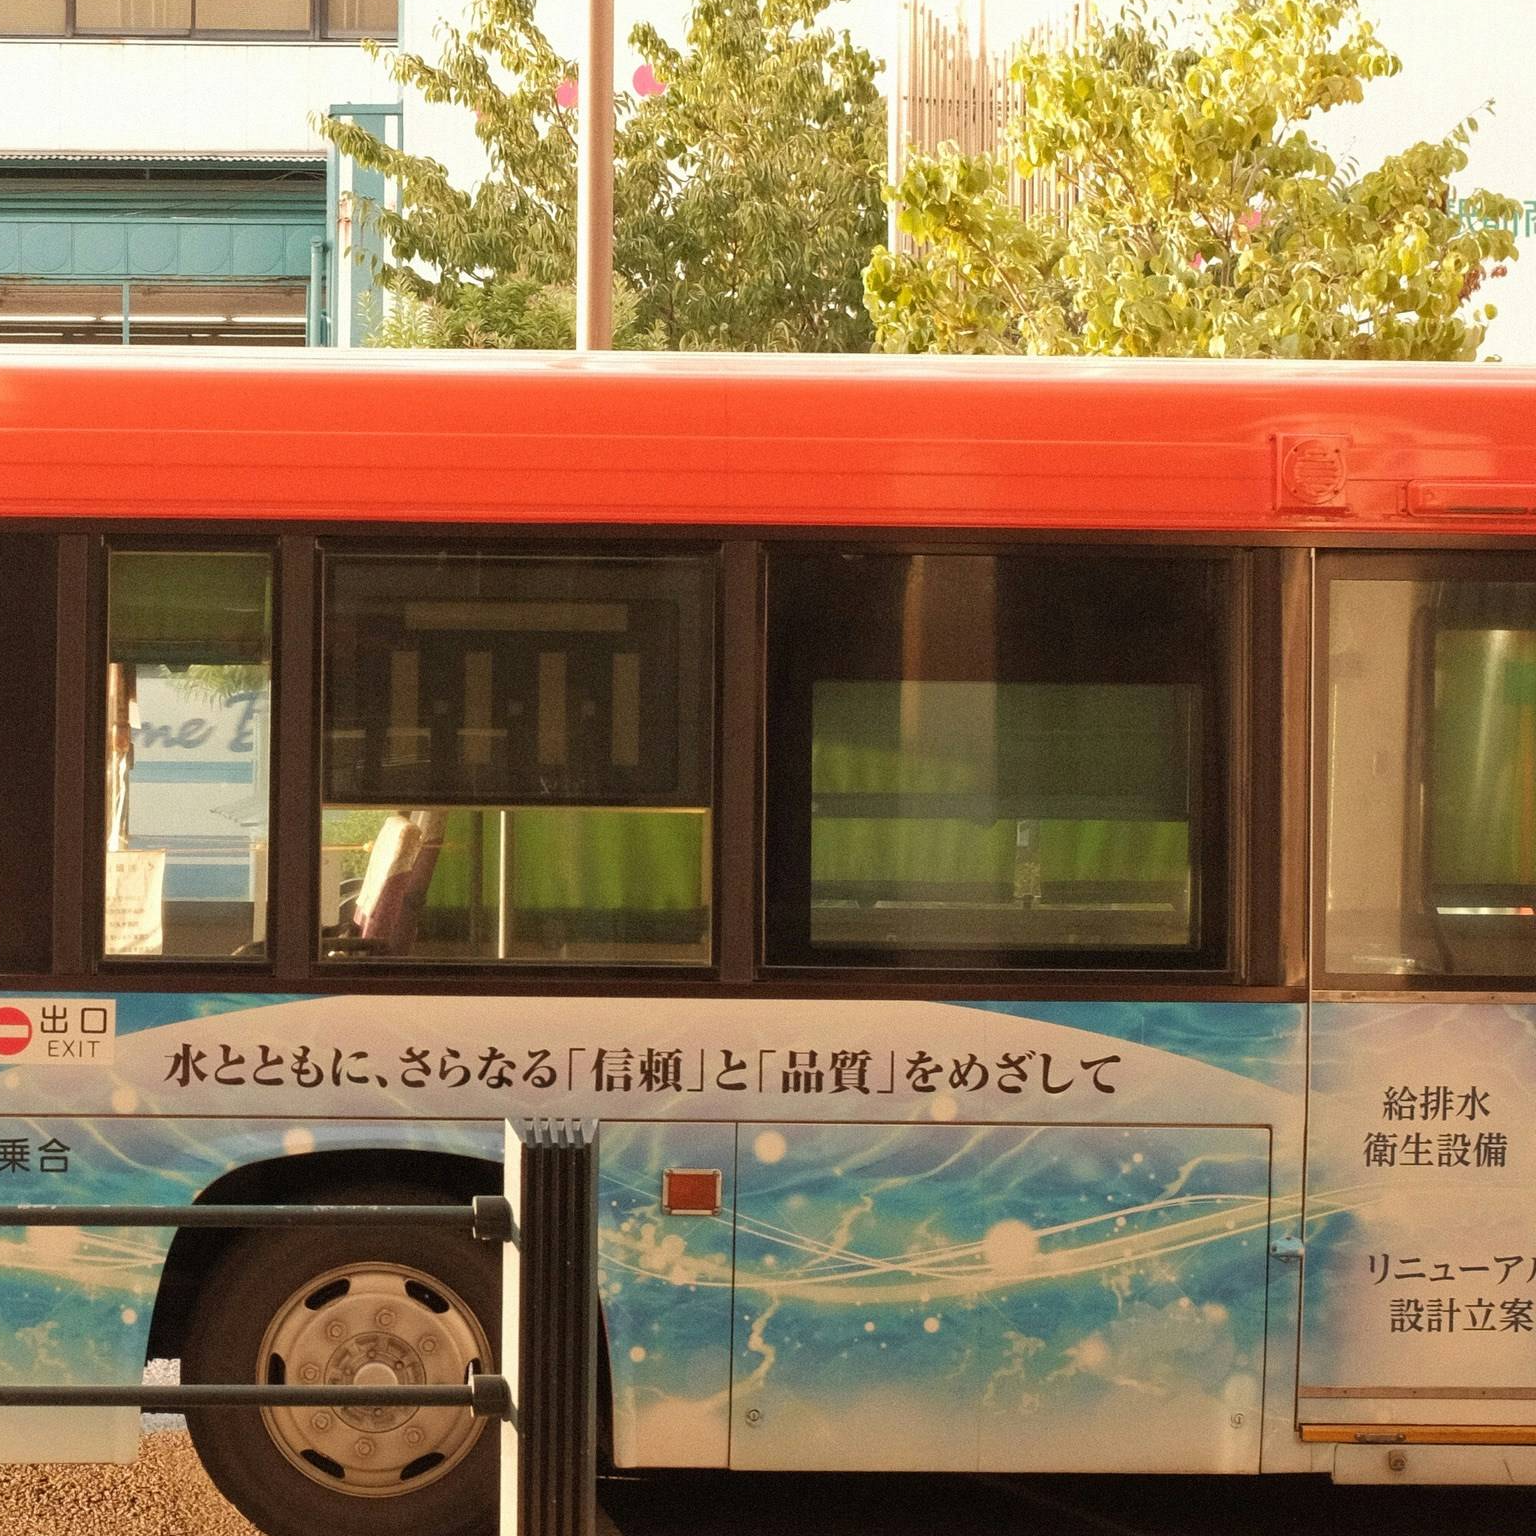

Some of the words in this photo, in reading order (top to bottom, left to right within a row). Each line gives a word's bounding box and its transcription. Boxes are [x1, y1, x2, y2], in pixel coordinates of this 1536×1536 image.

[40, 1005, 107, 1034] 出口
[48, 1040, 100, 1057] EXIT
[1382, 1086, 1490, 1121] 給排水
[1363, 1132, 1508, 1167] 衛生設備
[1389, 1297, 1534, 1333] 設計立案
